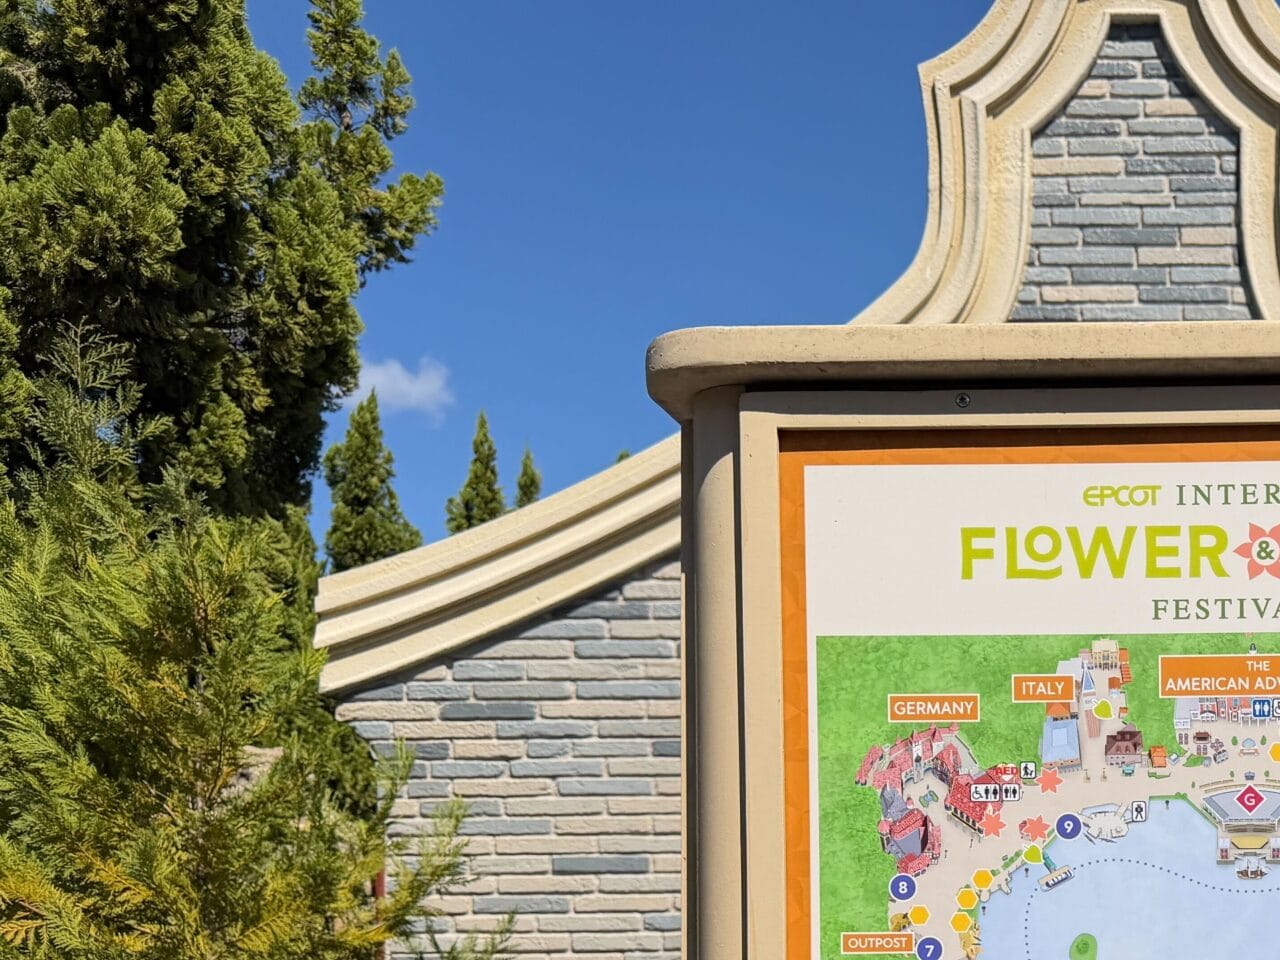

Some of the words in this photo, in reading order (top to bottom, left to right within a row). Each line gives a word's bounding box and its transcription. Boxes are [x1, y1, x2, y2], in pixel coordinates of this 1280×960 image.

[1082, 484, 1161, 507] EPCOT
[960, 524, 1229, 580] FLOWER
[1255, 539, 1275, 561] &
[1245, 660, 1271, 672] THE
[1022, 681, 1065, 696] ITALY
[1165, 676, 1250, 691] AMERICAN
[893, 701, 974, 716] GERMANY
[996, 767, 1018, 776] AED
[1243, 793, 1256, 806] G
[1063, 820, 1074, 833] 9
[898, 881, 908, 894] 8
[847, 937, 908, 949] OUTPOST
[924, 944, 935, 958] 7
